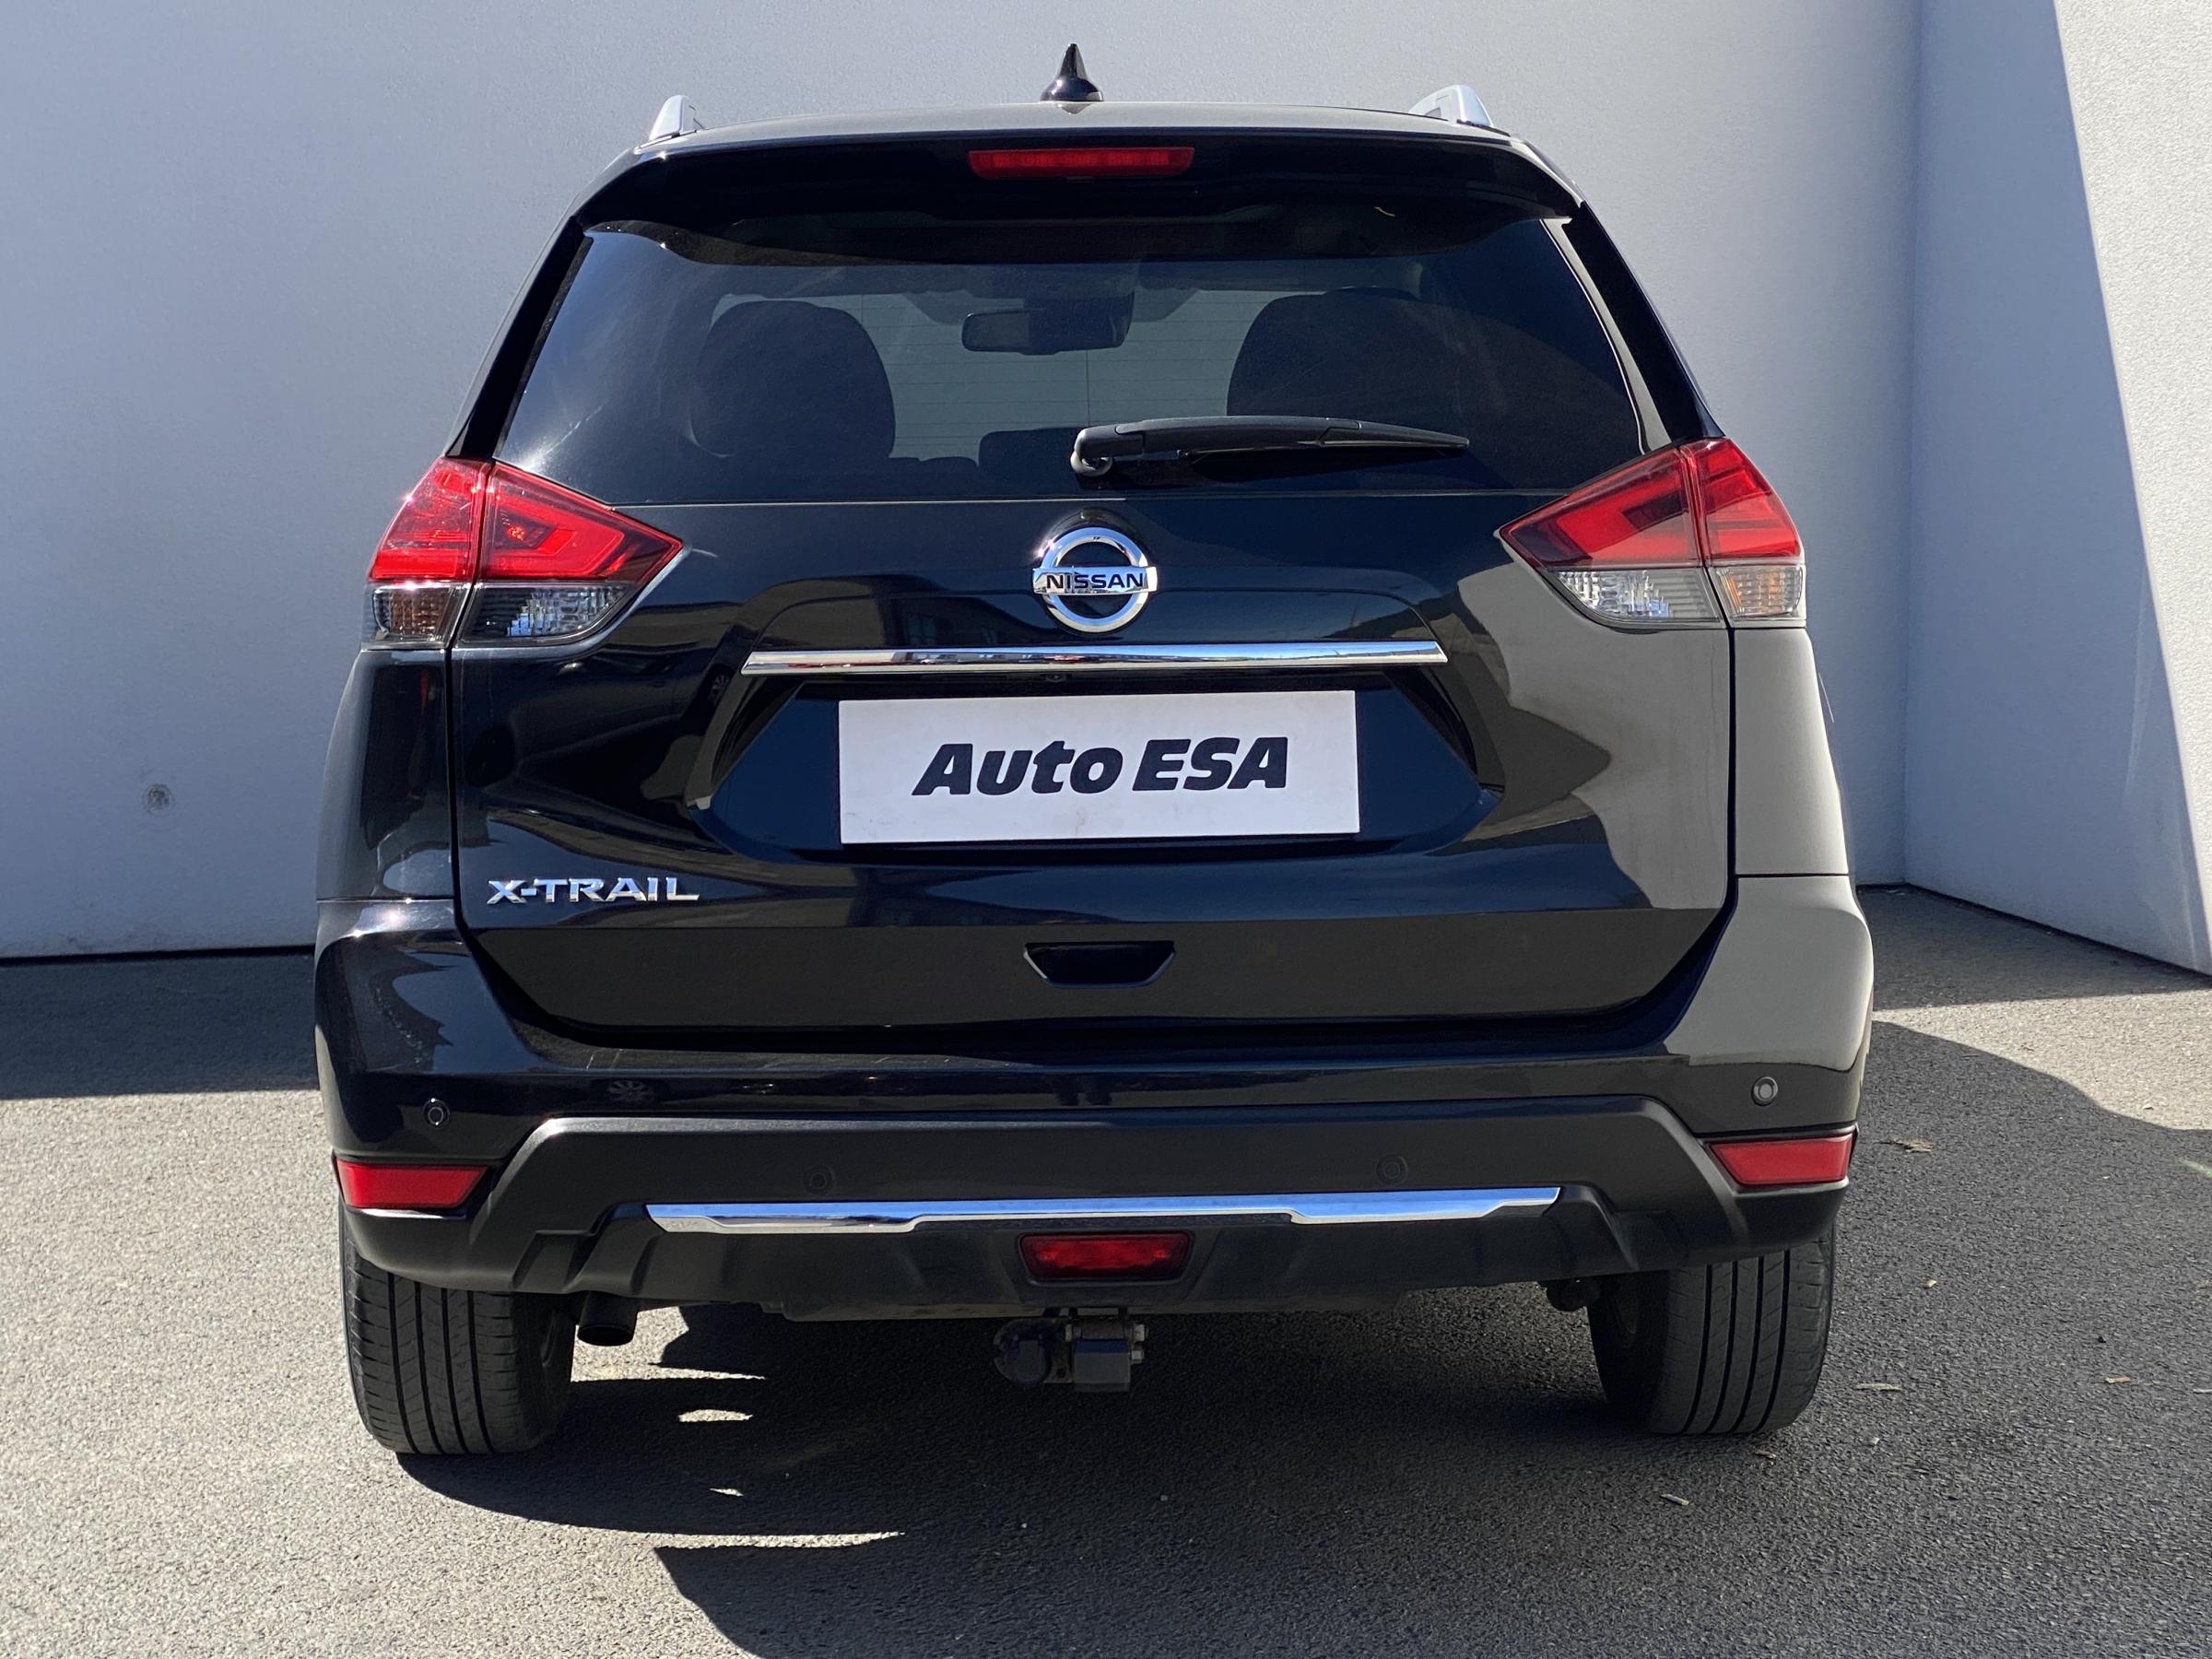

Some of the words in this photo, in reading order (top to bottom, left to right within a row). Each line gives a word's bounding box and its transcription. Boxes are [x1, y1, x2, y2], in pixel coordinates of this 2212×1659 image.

[1046, 572, 1144, 589] NISSAN
[911, 740, 1124, 795] Auto
[1132, 736, 1288, 791] ESA
[487, 877, 700, 904] X-TRAIL
